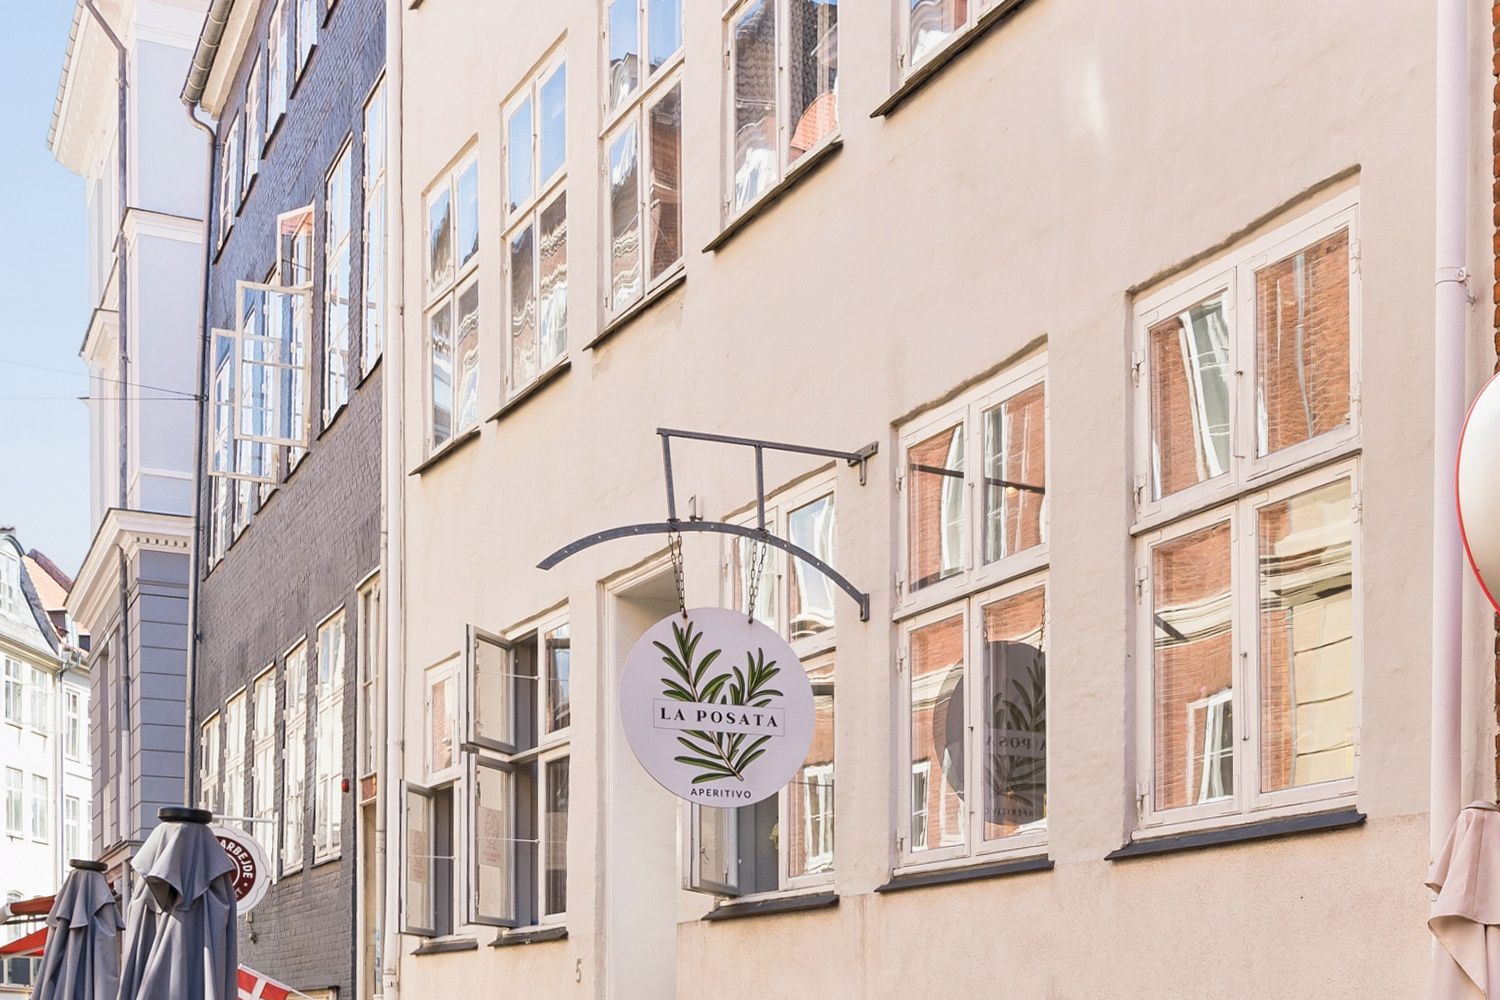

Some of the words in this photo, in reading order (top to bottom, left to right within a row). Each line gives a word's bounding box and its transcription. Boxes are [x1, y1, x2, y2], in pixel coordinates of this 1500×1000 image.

[660, 707, 686, 721] LA
[696, 709, 779, 728] POSATA
[690, 787, 752, 799] APERITIVO
[220, 839, 253, 879] ARBEJDE
[575, 958, 583, 984] 5
